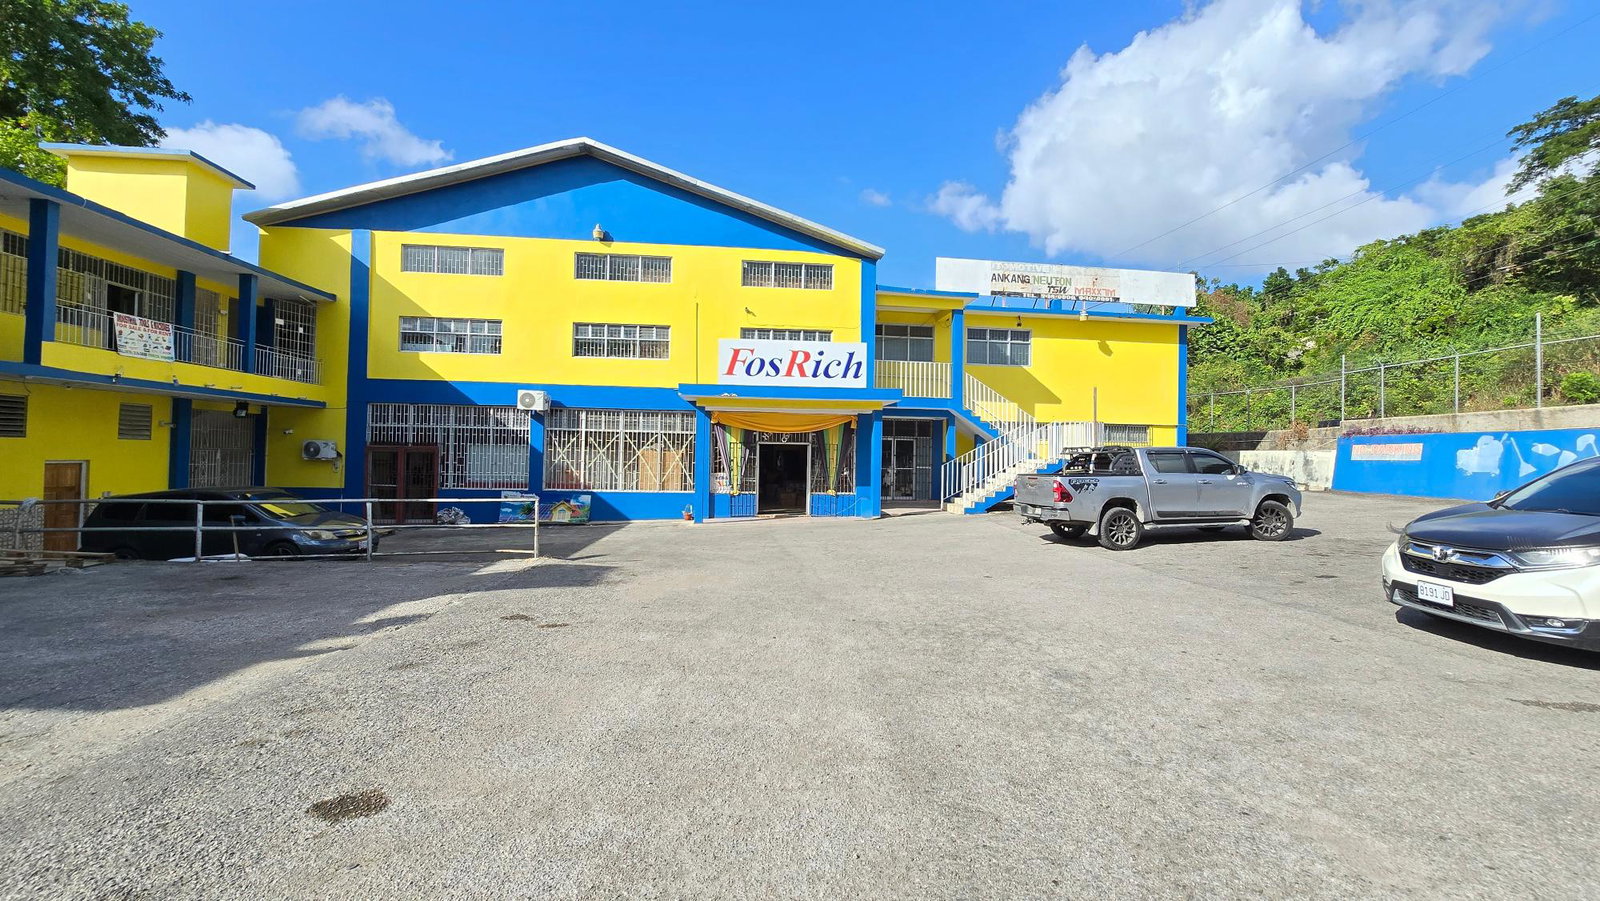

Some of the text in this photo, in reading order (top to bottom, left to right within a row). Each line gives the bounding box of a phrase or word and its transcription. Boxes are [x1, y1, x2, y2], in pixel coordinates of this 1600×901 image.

[991, 273, 1031, 284] ANKANG
[722, 347, 863, 379] FosRich
[1420, 585, 1438, 599] 8191
